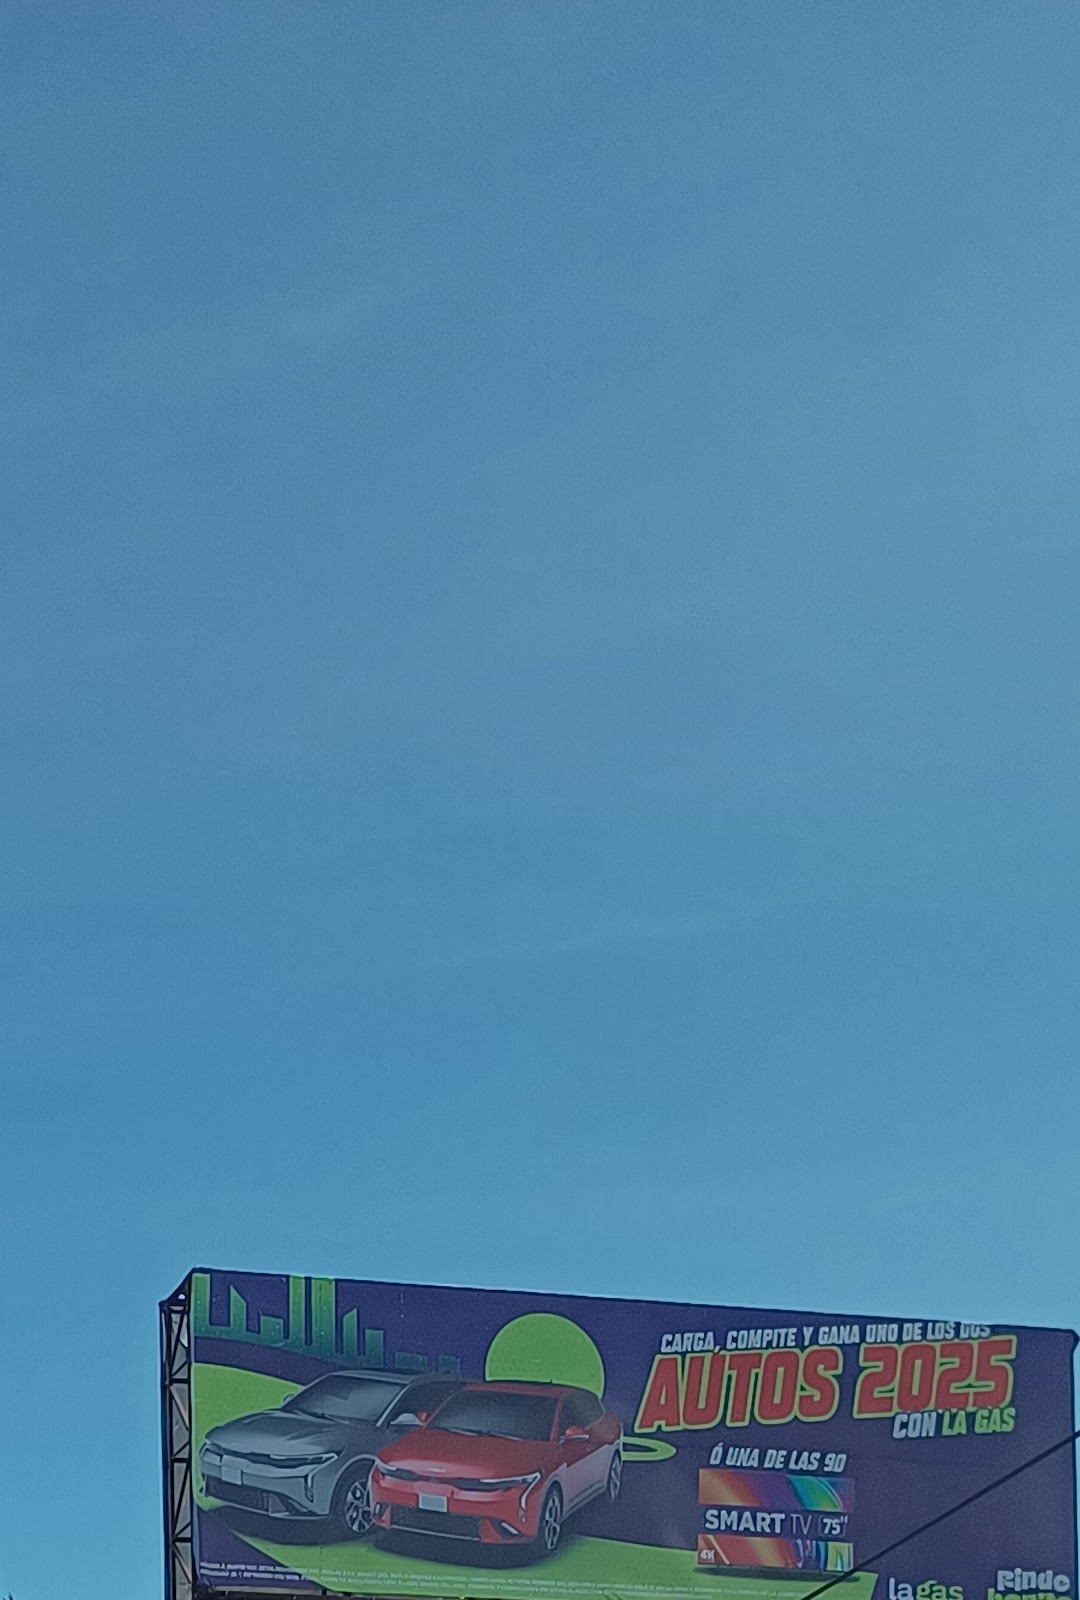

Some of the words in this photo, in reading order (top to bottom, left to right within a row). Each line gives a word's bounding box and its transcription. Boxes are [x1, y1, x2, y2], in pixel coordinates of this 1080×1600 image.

[660, 1331, 720, 1353] CARGA,
[726, 1327, 797, 1349] COMPITE
[802, 1325, 814, 1346] Y
[818, 1324, 860, 1345] GANA
[865, 1323, 898, 1343] UNO
[902, 1322, 923, 1341] DE
[926, 1320, 956, 1340] LOS
[634, 1344, 844, 1433] AUTOS
[853, 1334, 1017, 1419] 2025
[893, 1410, 937, 1439] CON
[941, 1409, 967, 1436] LA
[974, 1407, 1016, 1434] GAS
[725, 1446, 760, 1468] UNA
[763, 1449, 787, 1469] DE
[788, 1451, 821, 1471] LAS
[823, 1453, 847, 1473] 90
[705, 1509, 785, 1534] SMART
[790, 1513, 812, 1536] TV
[996, 1567, 1071, 1592] Rinde
